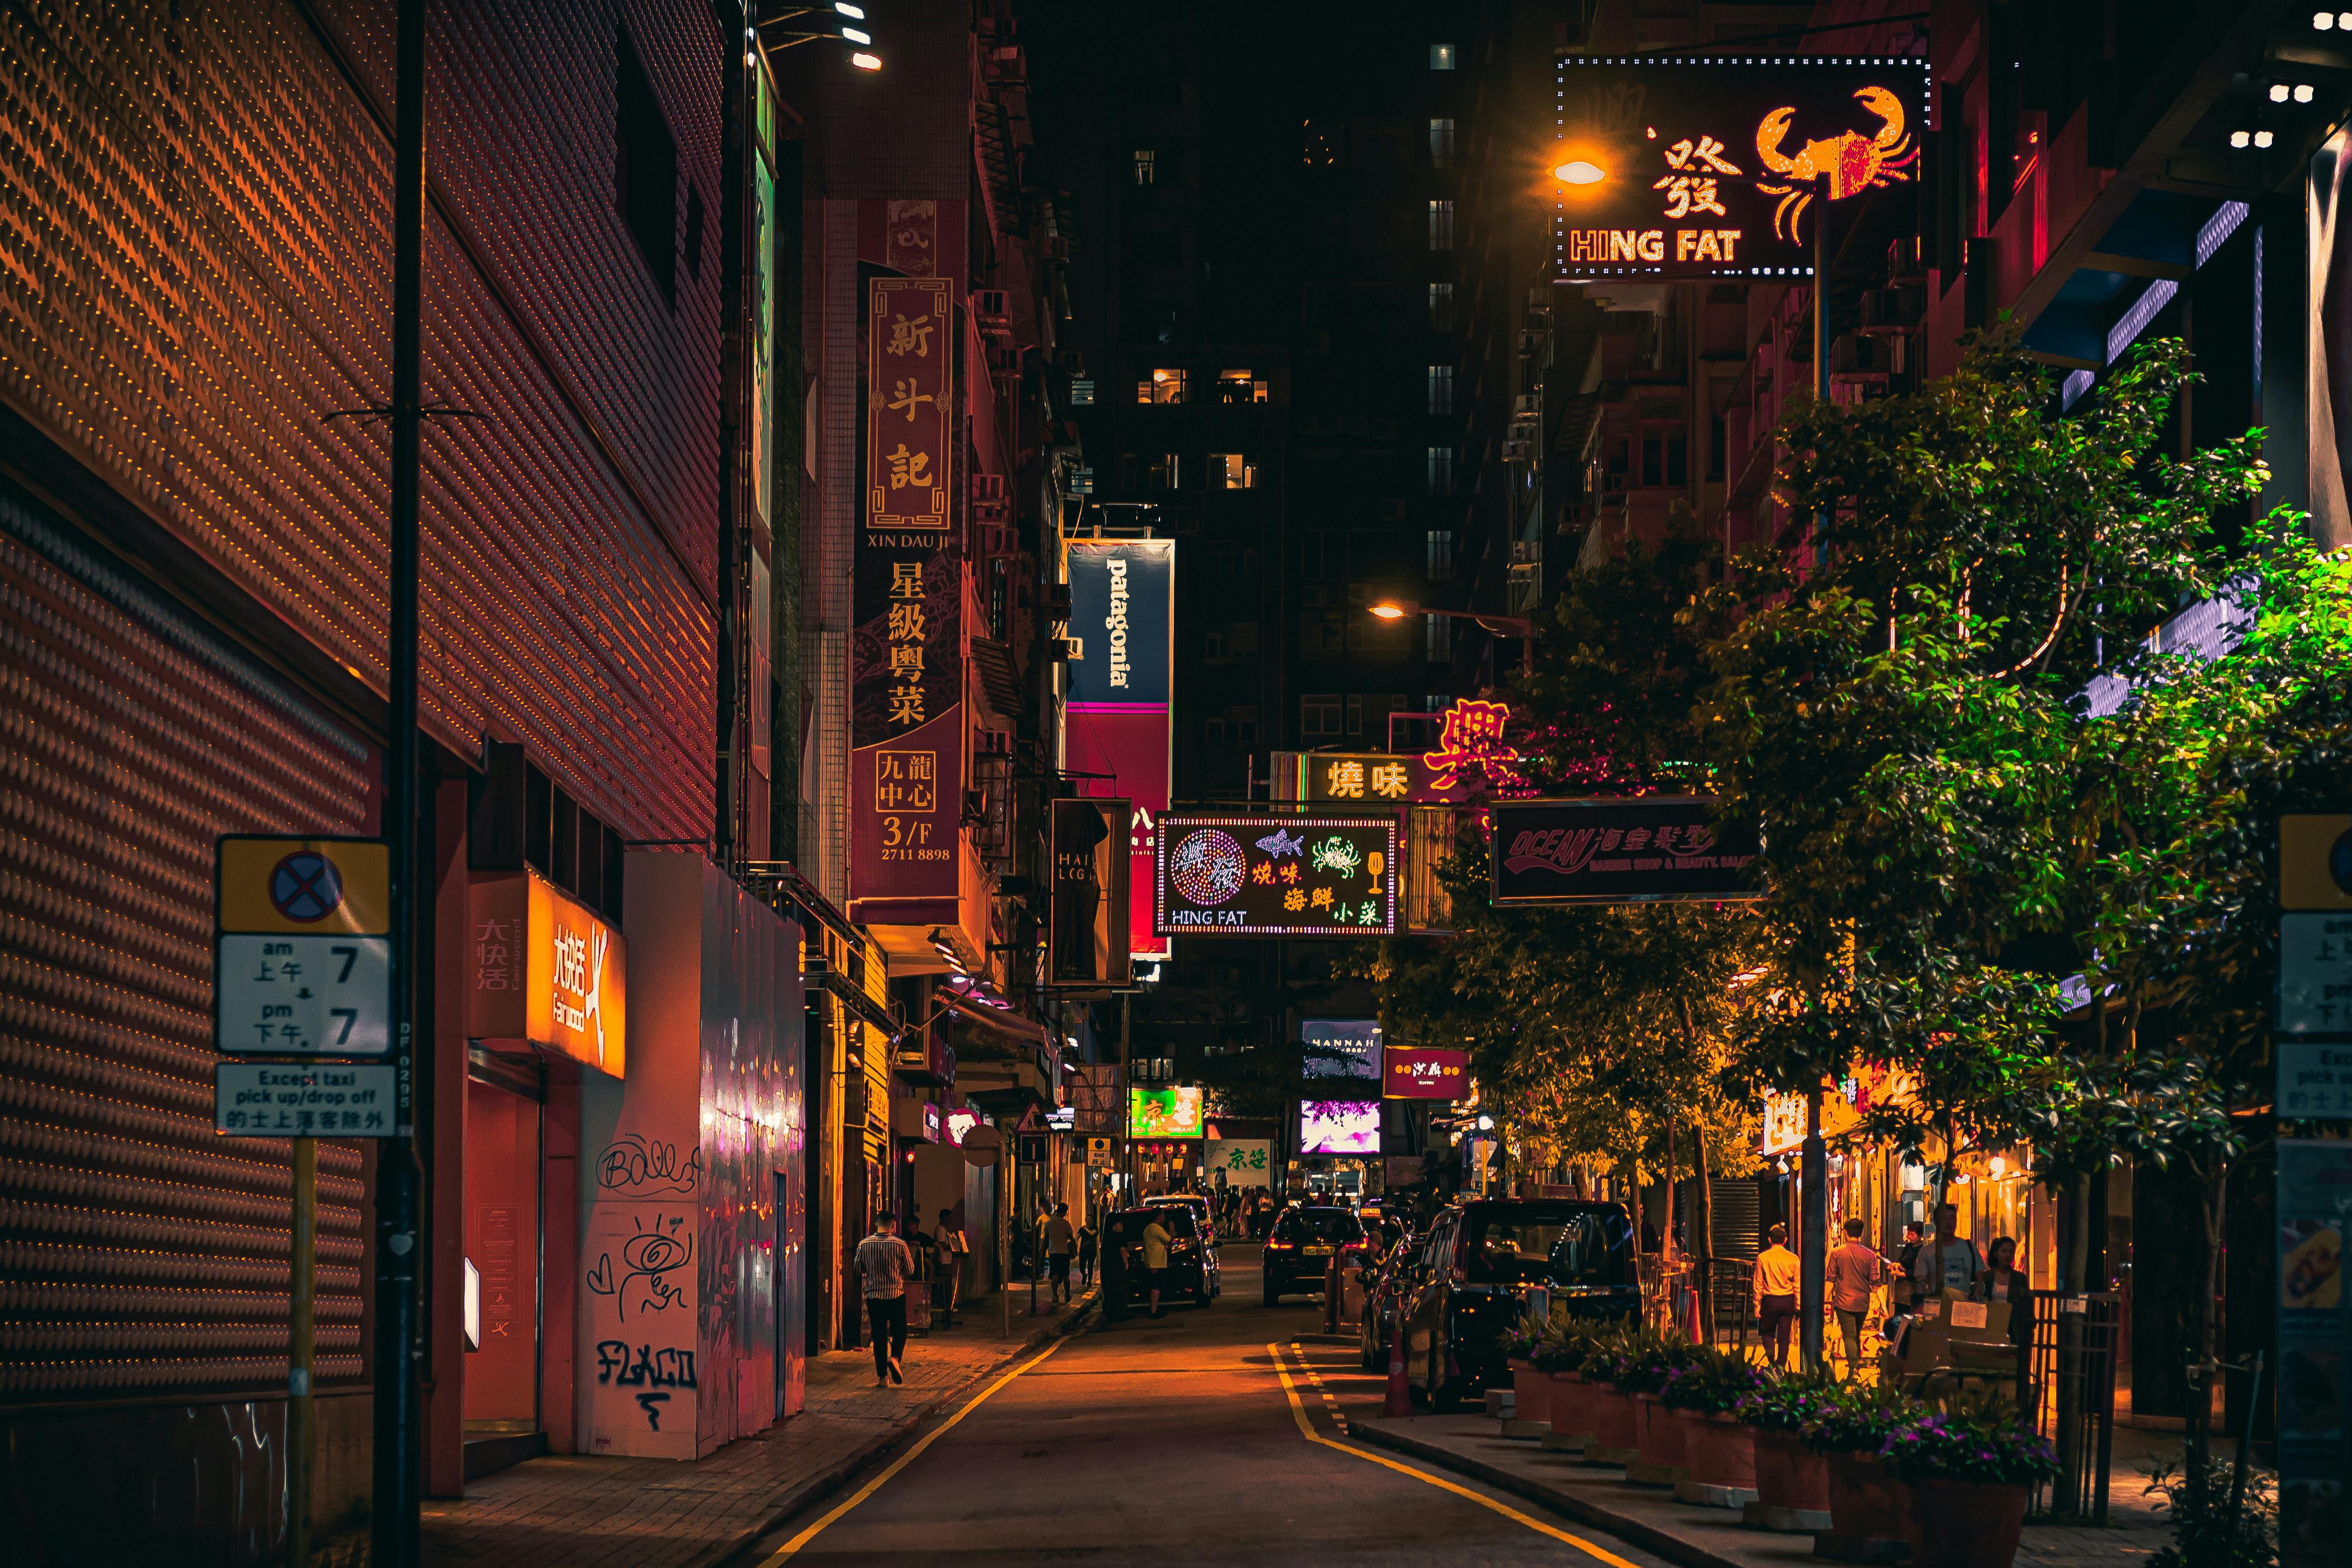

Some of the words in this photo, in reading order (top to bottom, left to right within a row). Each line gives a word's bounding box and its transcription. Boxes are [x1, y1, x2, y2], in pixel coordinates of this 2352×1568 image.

[1571, 230, 1664, 262] HING
[1676, 230, 1741, 262] FAT
[886, 313, 934, 490] 新斗記
[868, 534, 896, 547] XIN
[901, 534, 934, 547] DAU
[937, 534, 949, 551] JI
[1106, 559, 1131, 688] patagonia
[888, 561, 926, 724] 星級粵菜
[881, 755, 931, 779] 九龍
[1328, 761, 1408, 799] 燒味
[880, 783, 931, 808] 中心
[884, 816, 932, 846] 3/F
[882, 849, 913, 860] 2711
[918, 849, 950, 861] 8898
[1509, 828, 1596, 866] OCEAN
[1590, 858, 1632, 871] BARBER
[1633, 858, 1662, 871] SHOP
[1665, 858, 1672, 870] &
[1284, 887, 1334, 912] 海鮮
[1173, 911, 1212, 924] HING
[1218, 911, 1247, 924] FAT
[263, 943, 293, 956] am
[477, 919, 509, 990] 大快活
[553, 923, 586, 998] 大快活
[254, 961, 302, 983] 上午
[330, 946, 357, 984] 7
[262, 1005, 292, 1020] pm
[253, 1022, 302, 1044] 下午
[330, 1008, 357, 1046] 7
[259, 1070, 318, 1089] Except
[323, 1071, 356, 1086] taxi
[237, 1089, 272, 1105] pick
[278, 1090, 346, 1105] up/drop
[351, 1089, 376, 1104] off
[226, 1111, 383, 1129] 的士上落客除外
